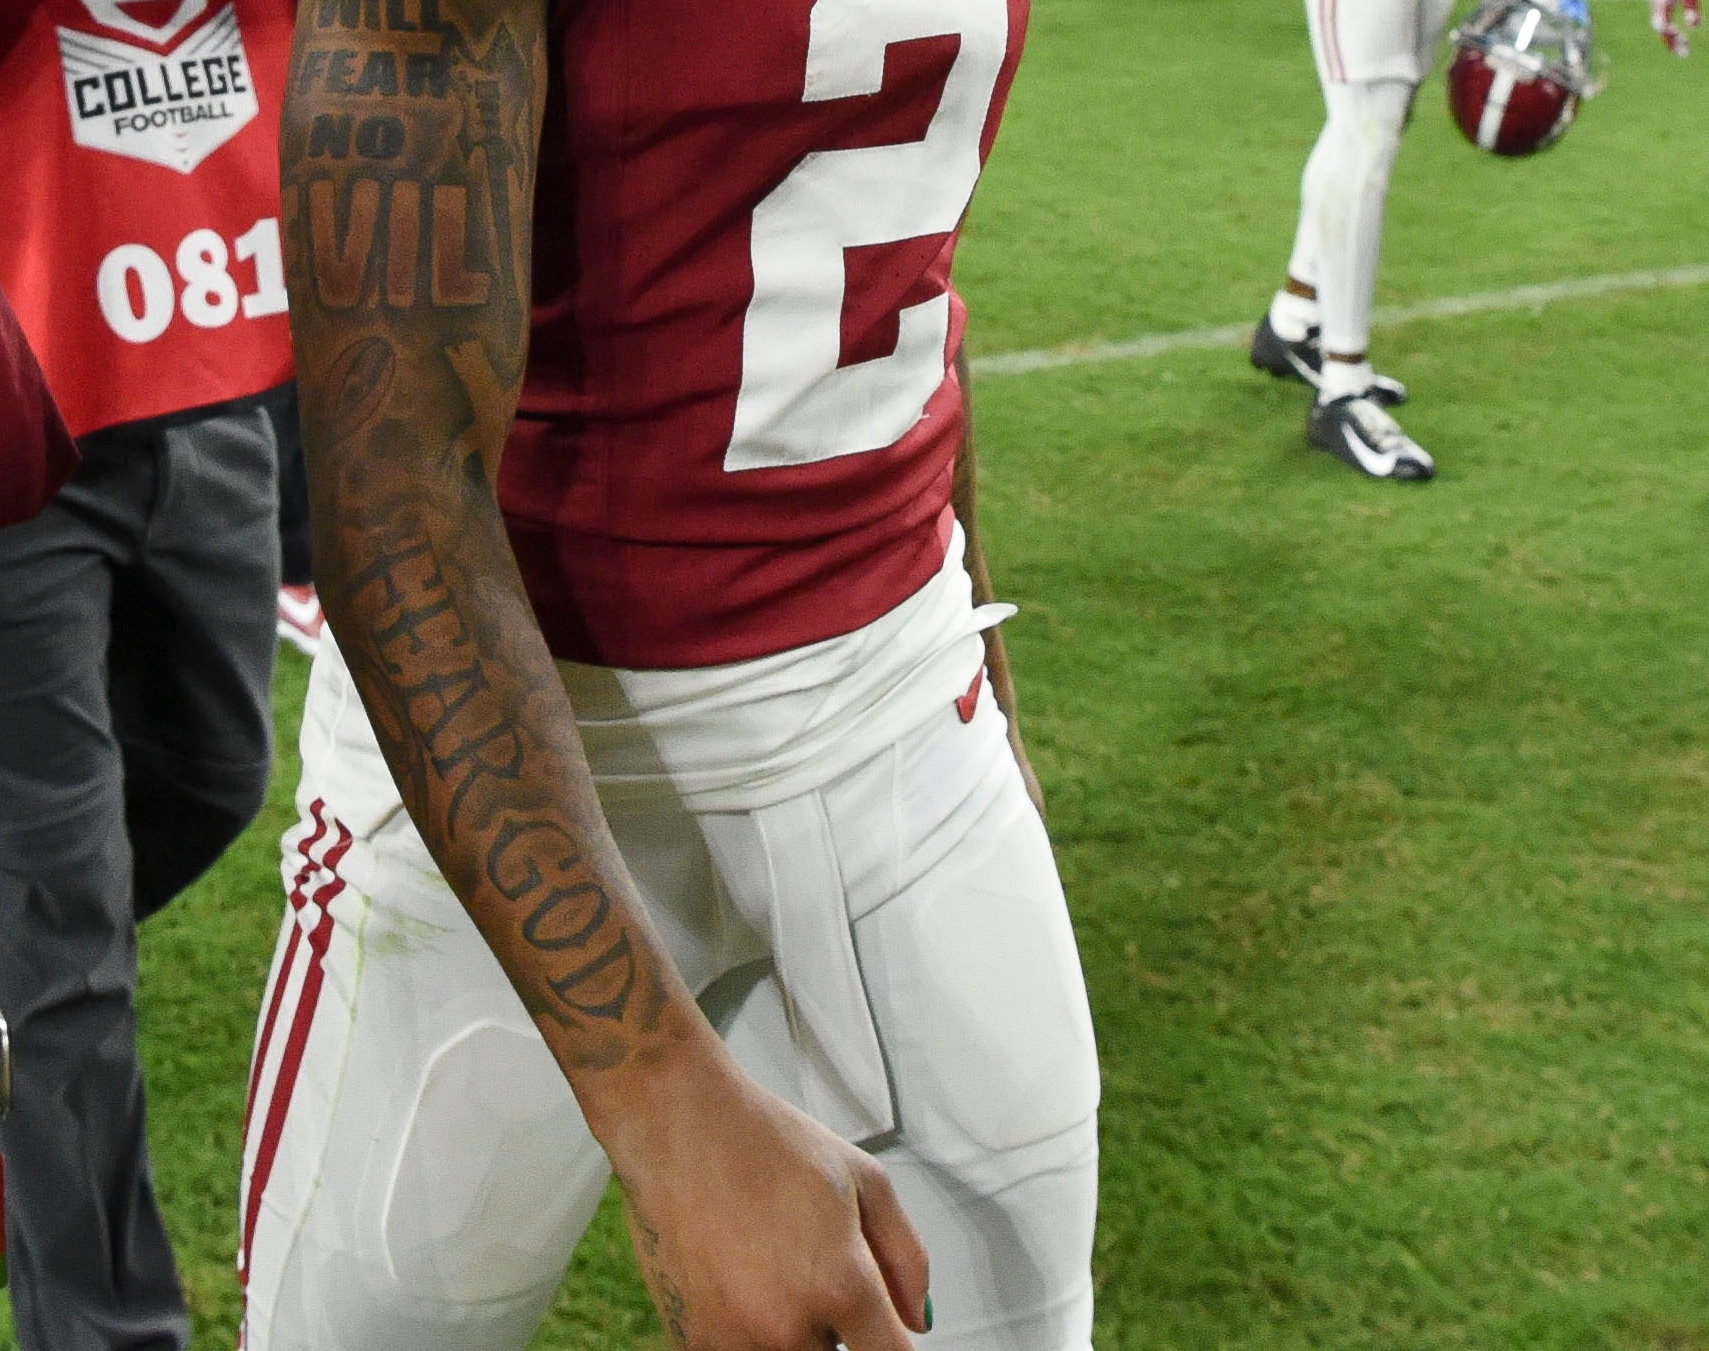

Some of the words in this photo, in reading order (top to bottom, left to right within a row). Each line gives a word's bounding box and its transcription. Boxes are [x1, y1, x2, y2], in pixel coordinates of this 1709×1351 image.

[73, 54, 248, 119] COLLEGE
[298, 49, 452, 99] FEAR
[113, 100, 234, 136] FOOTBALL
[307, 112, 407, 161] NO
[96, 217, 290, 344] 081
[487, 815, 636, 1022] GOD
